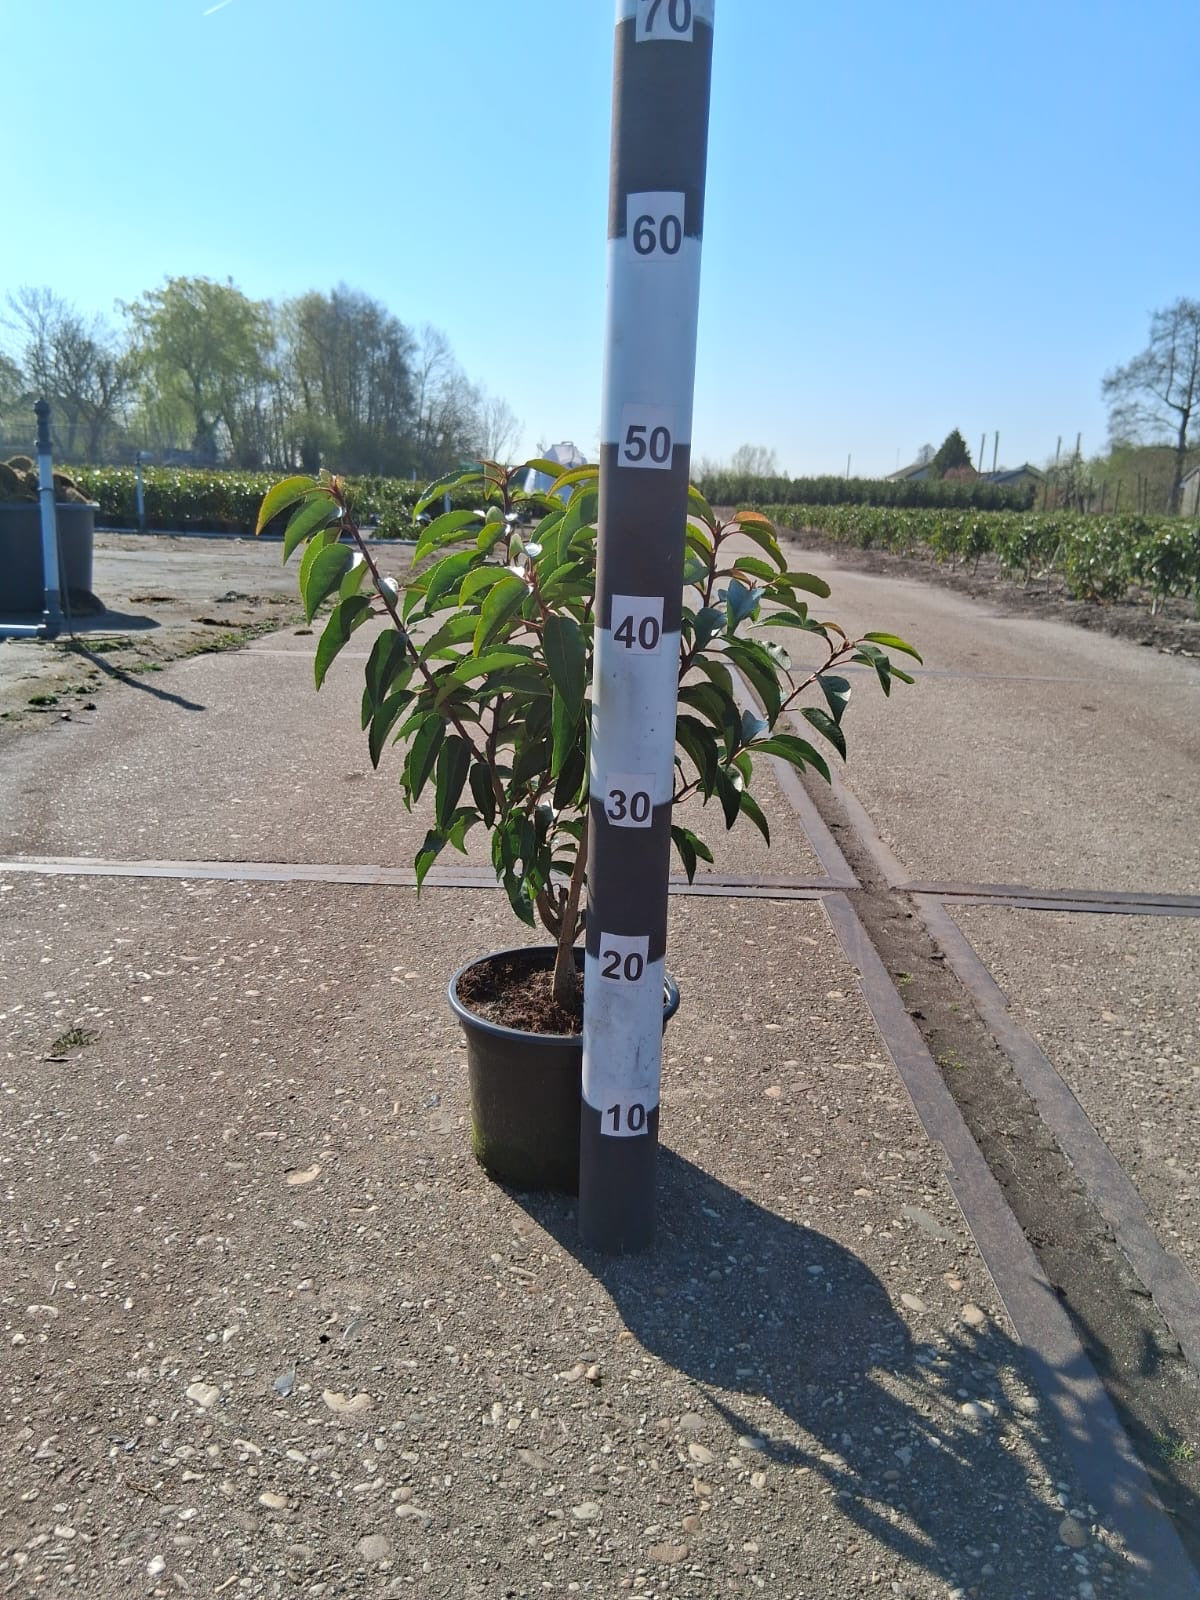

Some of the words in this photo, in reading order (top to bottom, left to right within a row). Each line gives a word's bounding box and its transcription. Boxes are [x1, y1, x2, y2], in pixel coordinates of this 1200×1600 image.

[642, 0, 691, 33] 70
[633, 215, 682, 255] 60
[624, 425, 671, 463] 50
[613, 615, 660, 650] 40
[607, 789, 651, 822] 30
[601, 950, 644, 981] 20
[607, 1103, 646, 1132] 10
